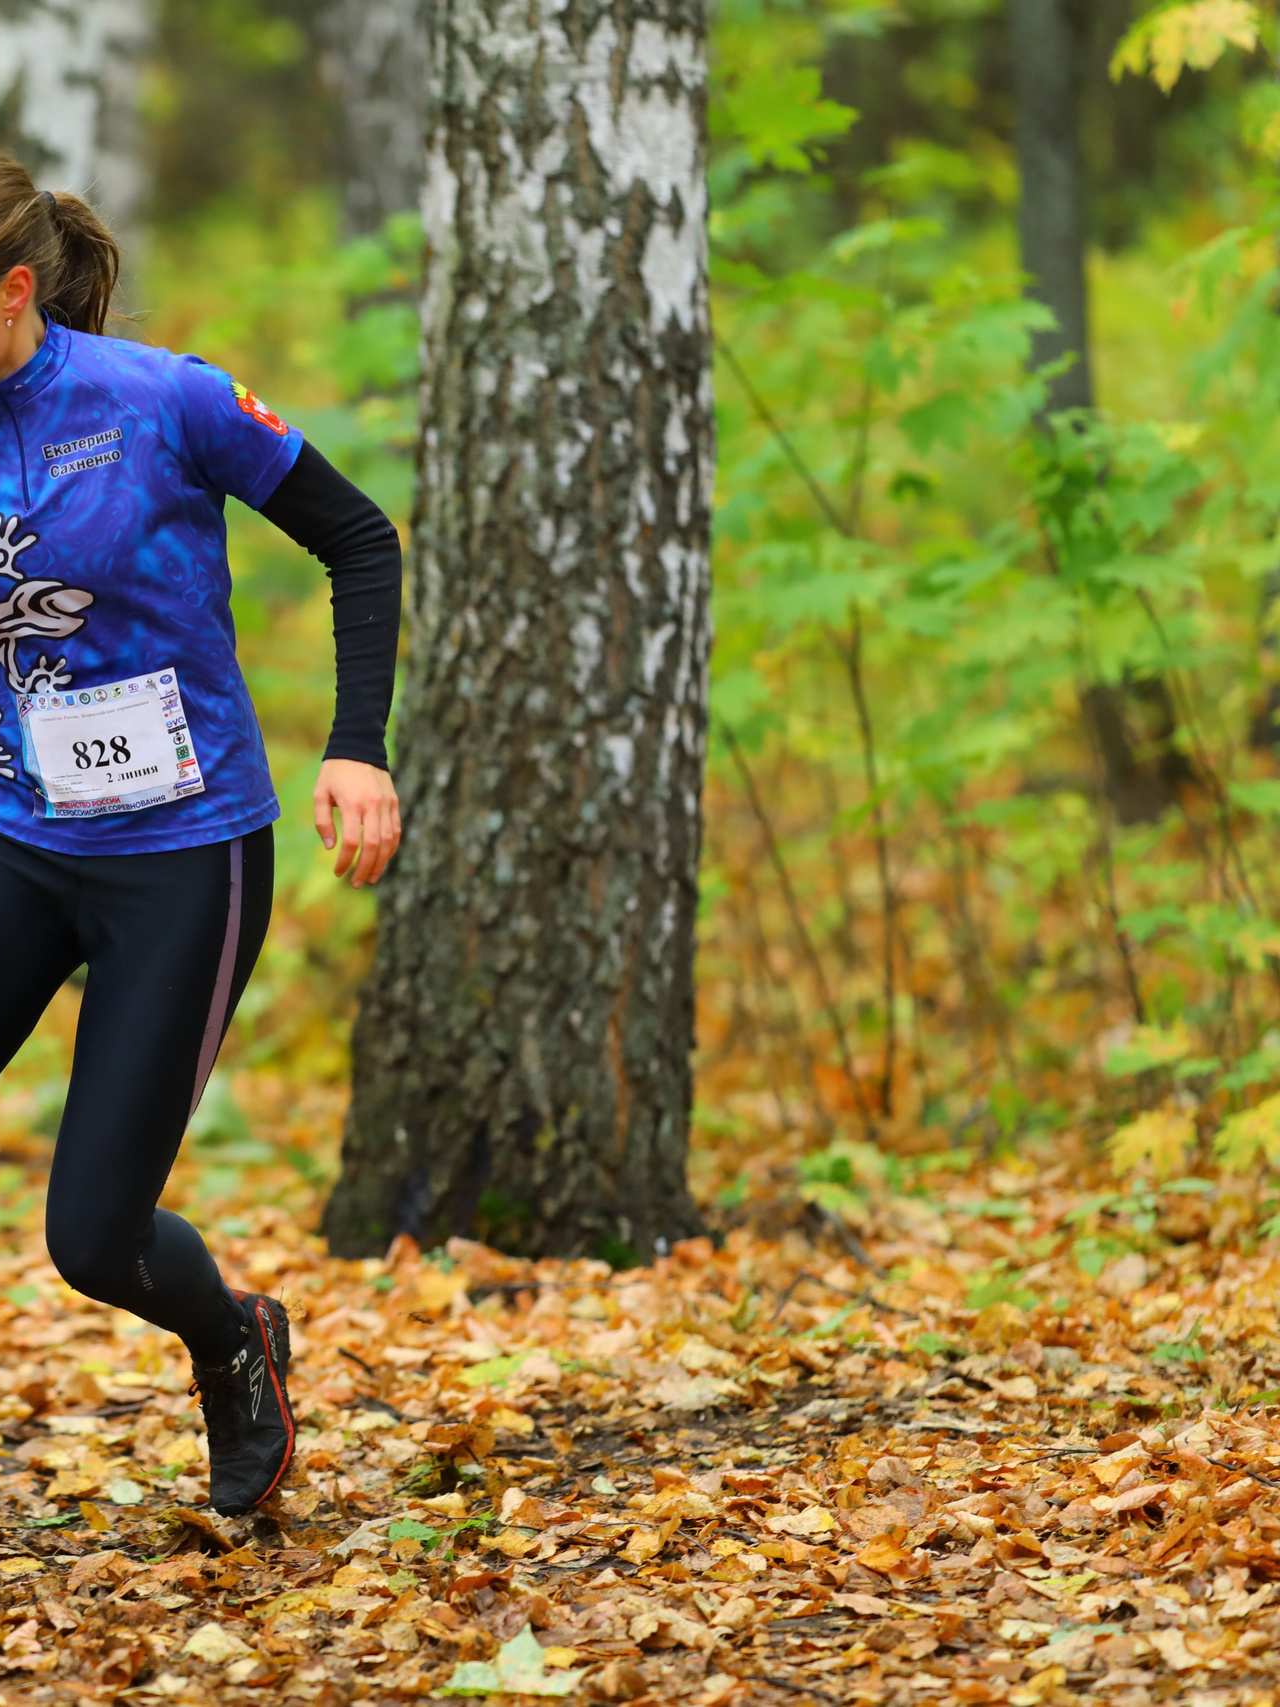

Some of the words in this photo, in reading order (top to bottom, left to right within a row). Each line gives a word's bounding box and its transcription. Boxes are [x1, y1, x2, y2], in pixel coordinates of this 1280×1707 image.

[43, 428, 121, 459] Екатерина
[50, 450, 120, 478] Сахненко
[166, 716, 185, 728] evo
[72, 735, 132, 770] 828
[106, 772, 114, 783] 2
[117, 765, 159, 782] линия
[92, 797, 121, 807] РОССИИ
[108, 794, 167, 812] СОРЕВНОВАНИЯ
